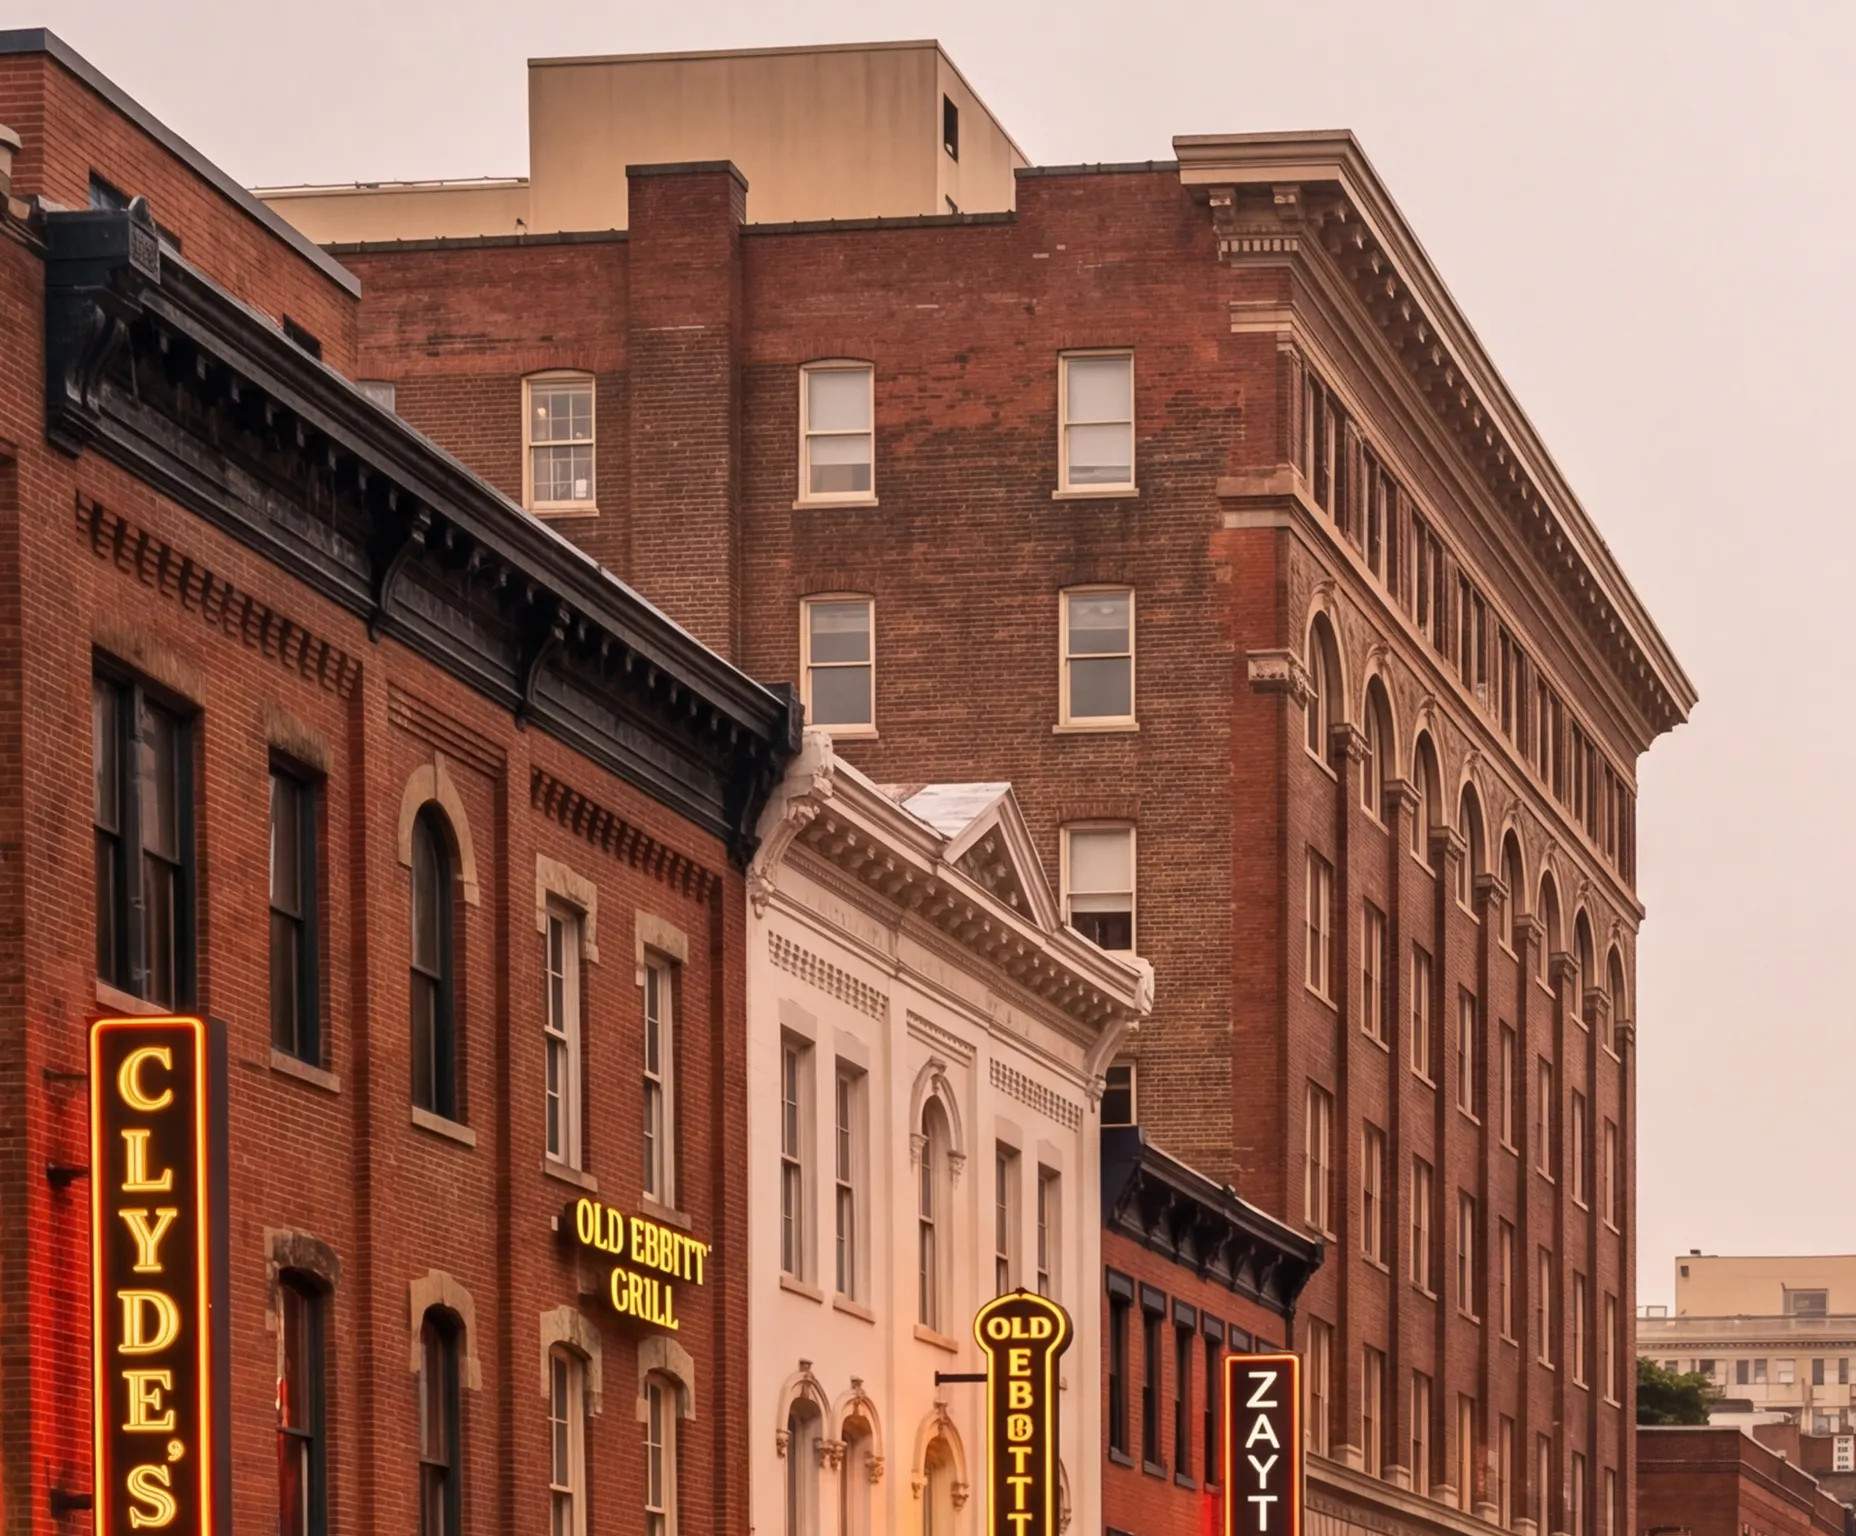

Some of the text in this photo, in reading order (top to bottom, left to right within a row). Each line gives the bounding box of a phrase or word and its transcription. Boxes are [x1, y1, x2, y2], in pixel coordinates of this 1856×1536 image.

[576, 1198, 708, 1286] OLD EBBITT
[116, 1046, 184, 1529] CLYDE'S
[611, 1267, 679, 1331] GRILL
[986, 1316, 1052, 1341] OLD
